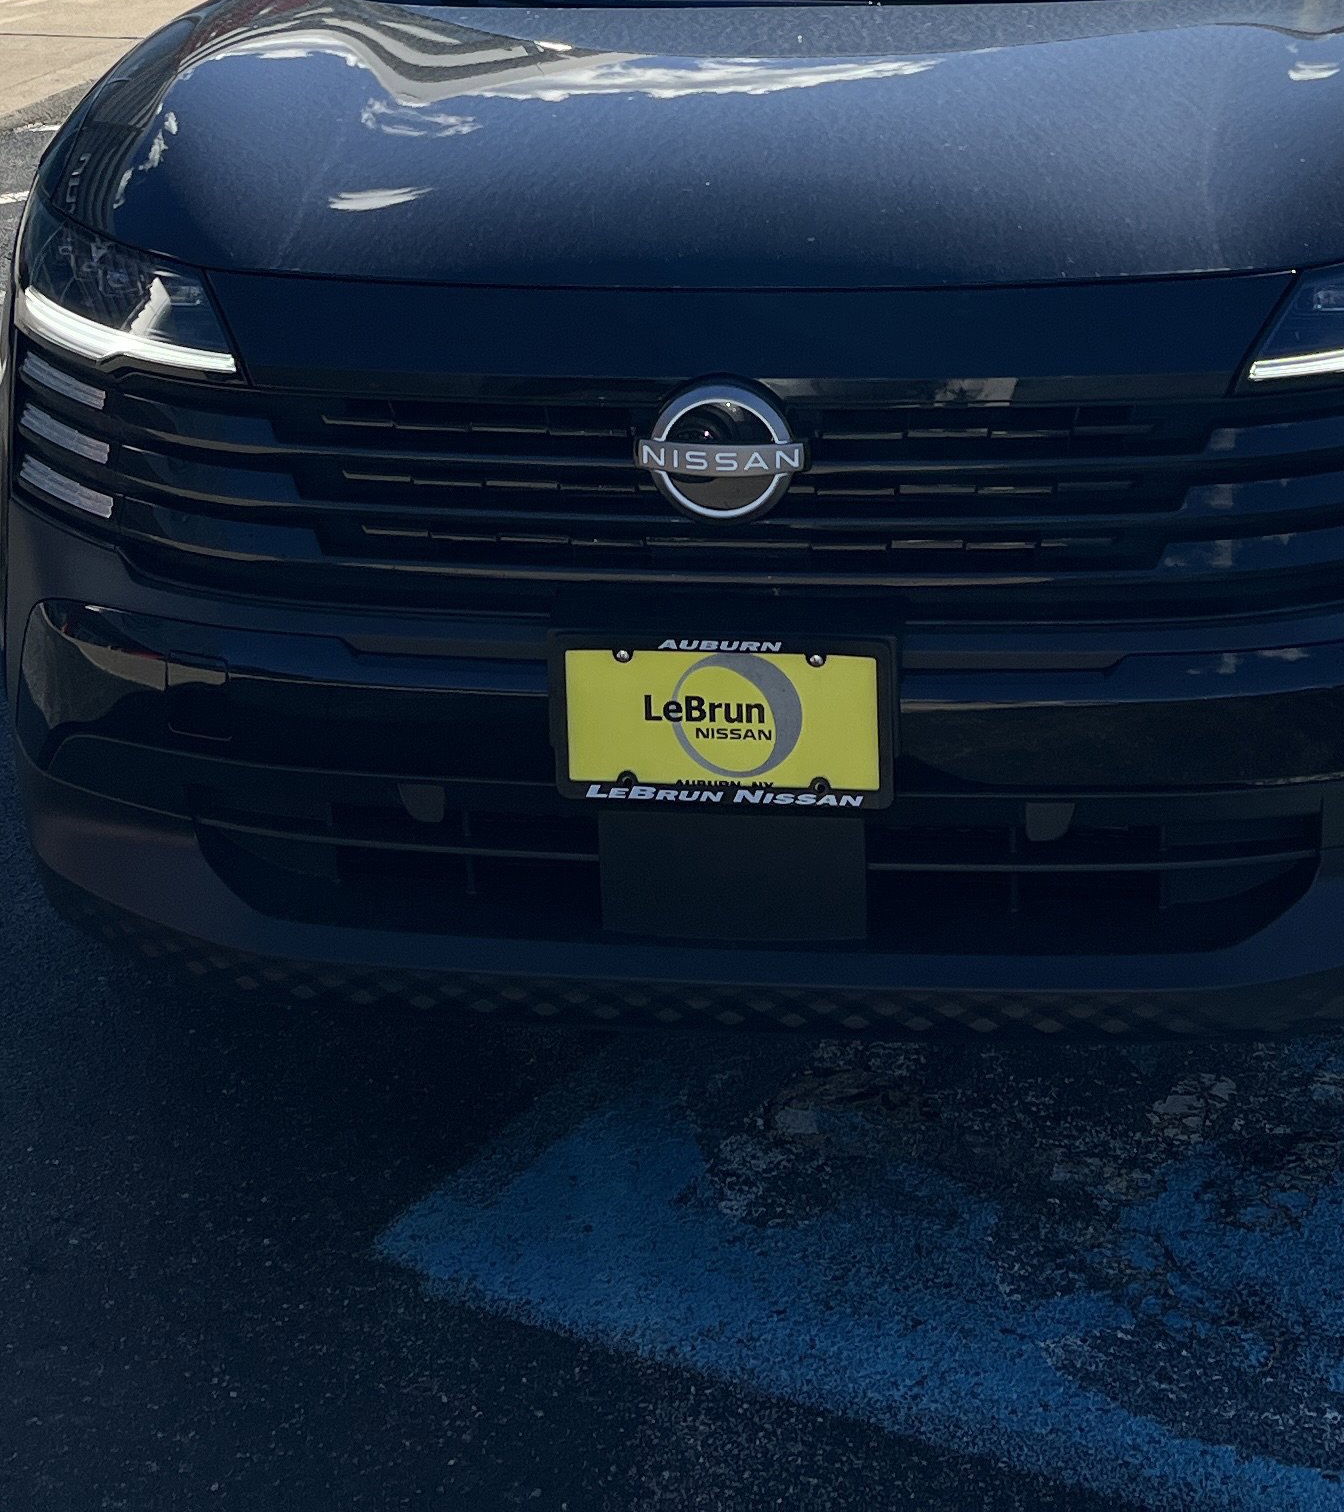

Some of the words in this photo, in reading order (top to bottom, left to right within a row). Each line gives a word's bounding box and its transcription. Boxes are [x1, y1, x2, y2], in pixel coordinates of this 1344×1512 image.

[642, 444, 800, 472] NISSAN
[658, 638, 783, 653] AUBURN
[644, 694, 766, 724] LeBrun
[695, 727, 773, 741] NISSAN
